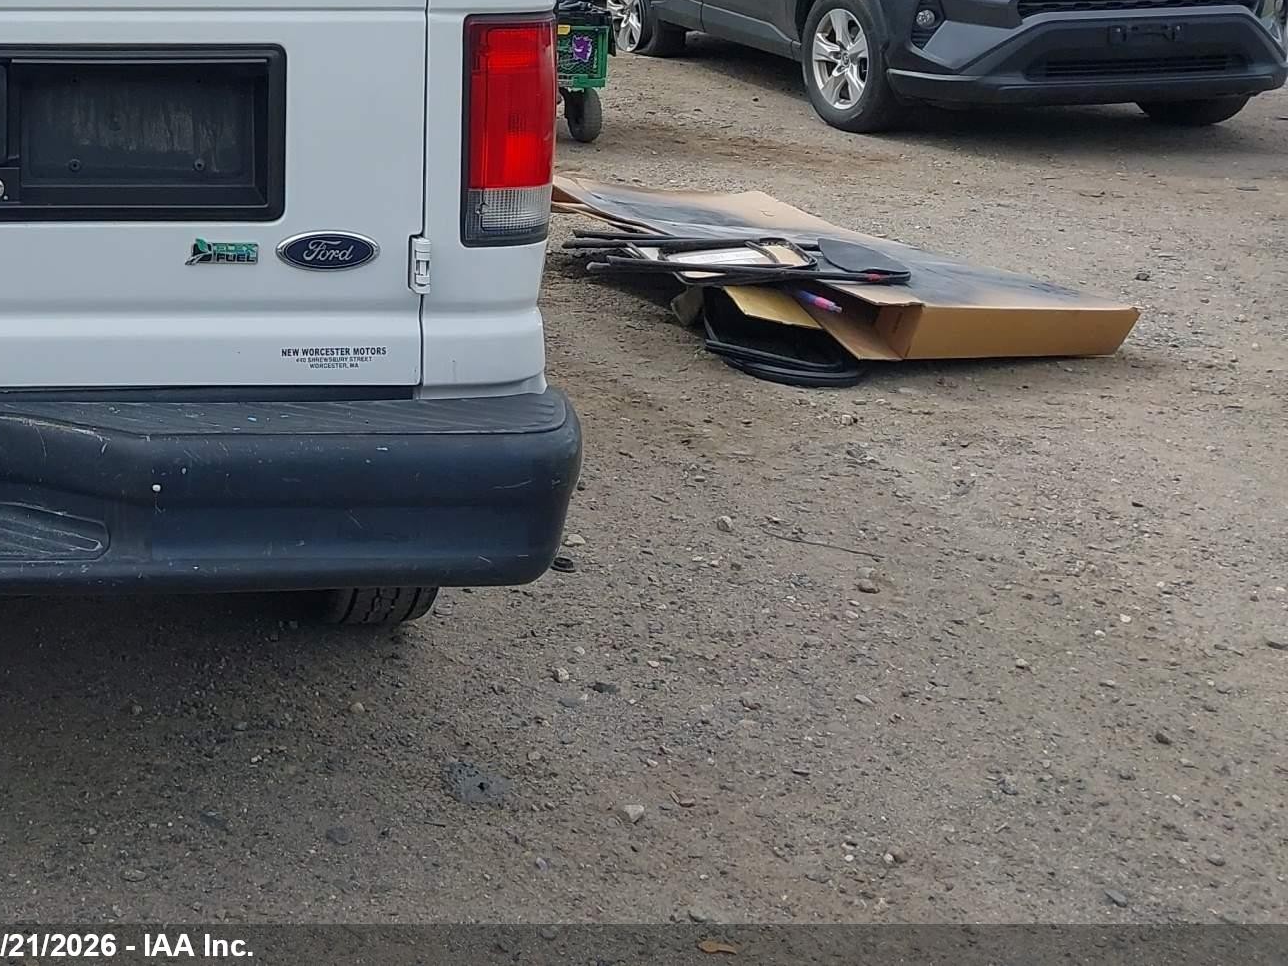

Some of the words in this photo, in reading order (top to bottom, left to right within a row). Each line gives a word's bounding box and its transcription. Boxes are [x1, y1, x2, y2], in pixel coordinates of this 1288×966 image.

[302, 239, 354, 261] Ford
[216, 252, 255, 263] FUEL
[281, 348, 300, 357] NEW
[301, 347, 351, 356] WORCESTER
[353, 347, 387, 356] MOTORS
